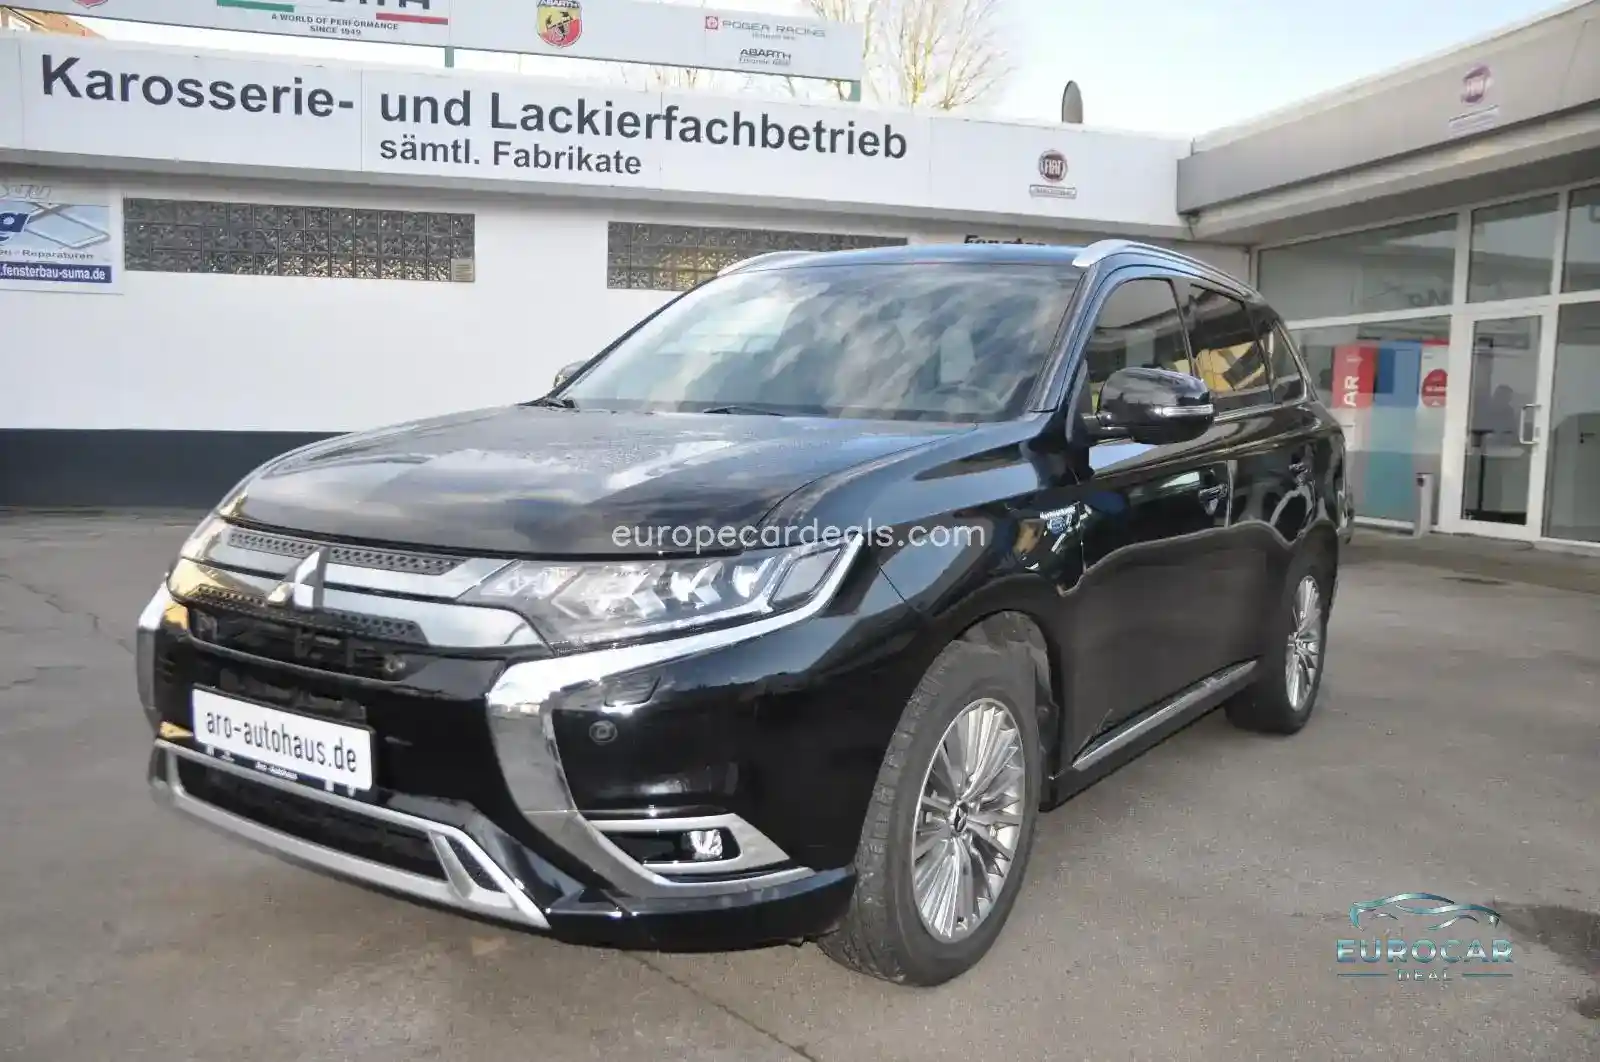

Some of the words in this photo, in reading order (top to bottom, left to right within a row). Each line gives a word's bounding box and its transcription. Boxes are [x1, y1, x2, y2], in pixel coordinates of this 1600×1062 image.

[280, 14, 313, 24] WORLD
[315, 17, 328, 25] OF
[330, 18, 399, 30] PERFORMANCE
[309, 25, 337, 34] SINCE
[340, 27, 362, 35] 1949
[740, 48, 791, 59] ABARTH
[42, 54, 354, 117] Karosserie-
[380, 90, 471, 126] und
[491, 92, 907, 159] Lackierfachbetrieb
[380, 134, 480, 164] sämtl.
[494, 140, 642, 175] Fabrikate
[22, 250, 94, 259] Reparaturen
[206, 711, 357, 773] aro-autohaus.de
